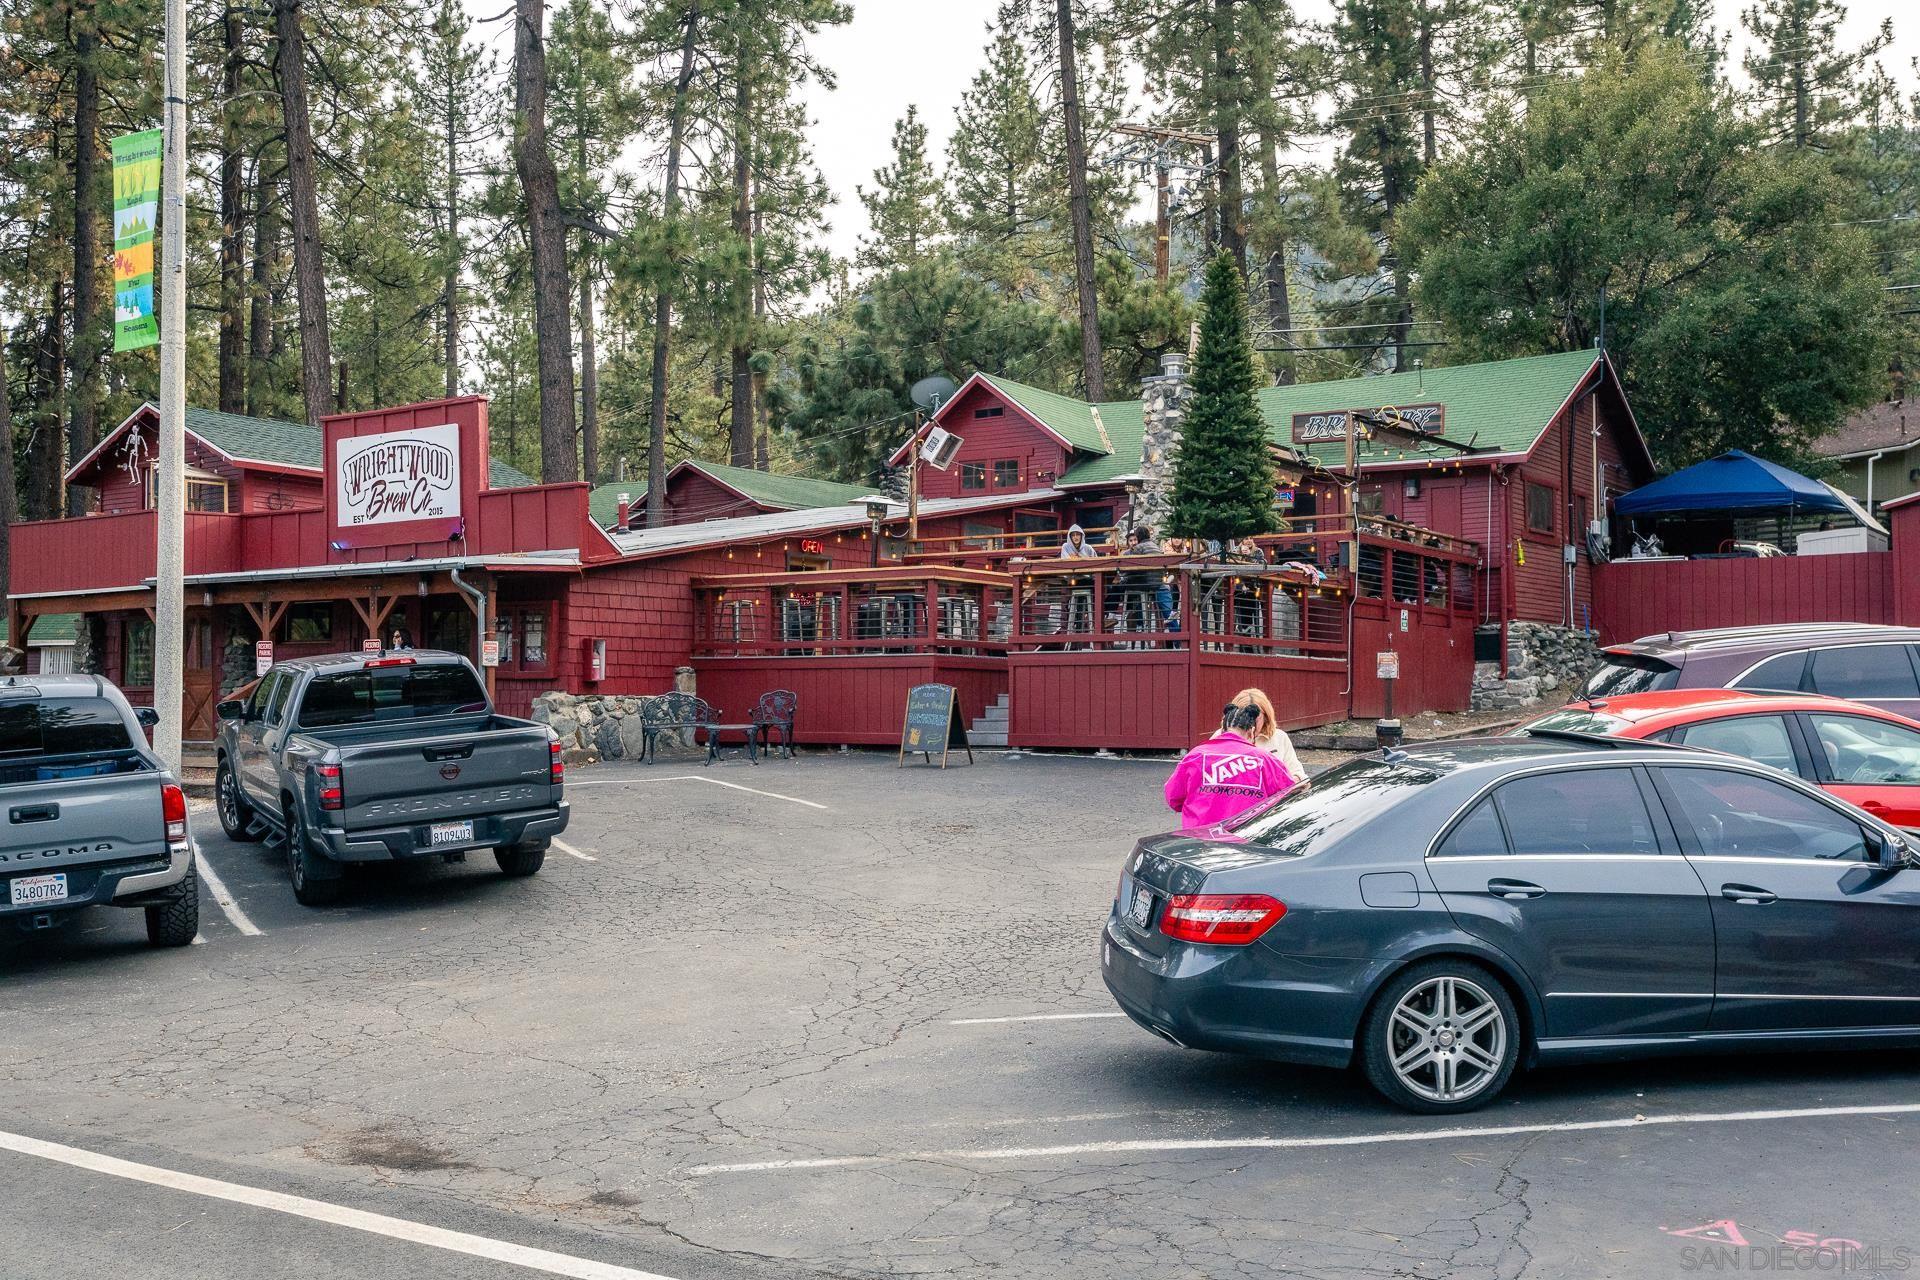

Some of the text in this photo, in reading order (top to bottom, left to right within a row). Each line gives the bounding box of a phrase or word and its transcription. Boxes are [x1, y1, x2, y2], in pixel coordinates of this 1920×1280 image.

[115, 146, 158, 164] Wrightwood
[127, 195, 143, 206] Land
[123, 322, 148, 333] Seasons
[348, 444, 449, 497] WRIGHTWOOD
[366, 476, 433, 520] Brew Co
[353, 507, 444, 524] EST 2015
[801, 539, 823, 554] OPEN
[1203, 754, 1258, 786] VANS
[366, 788, 533, 818] FRONTIER
[433, 828, 471, 843] 81094U3
[15, 883, 64, 901] 34807R2
